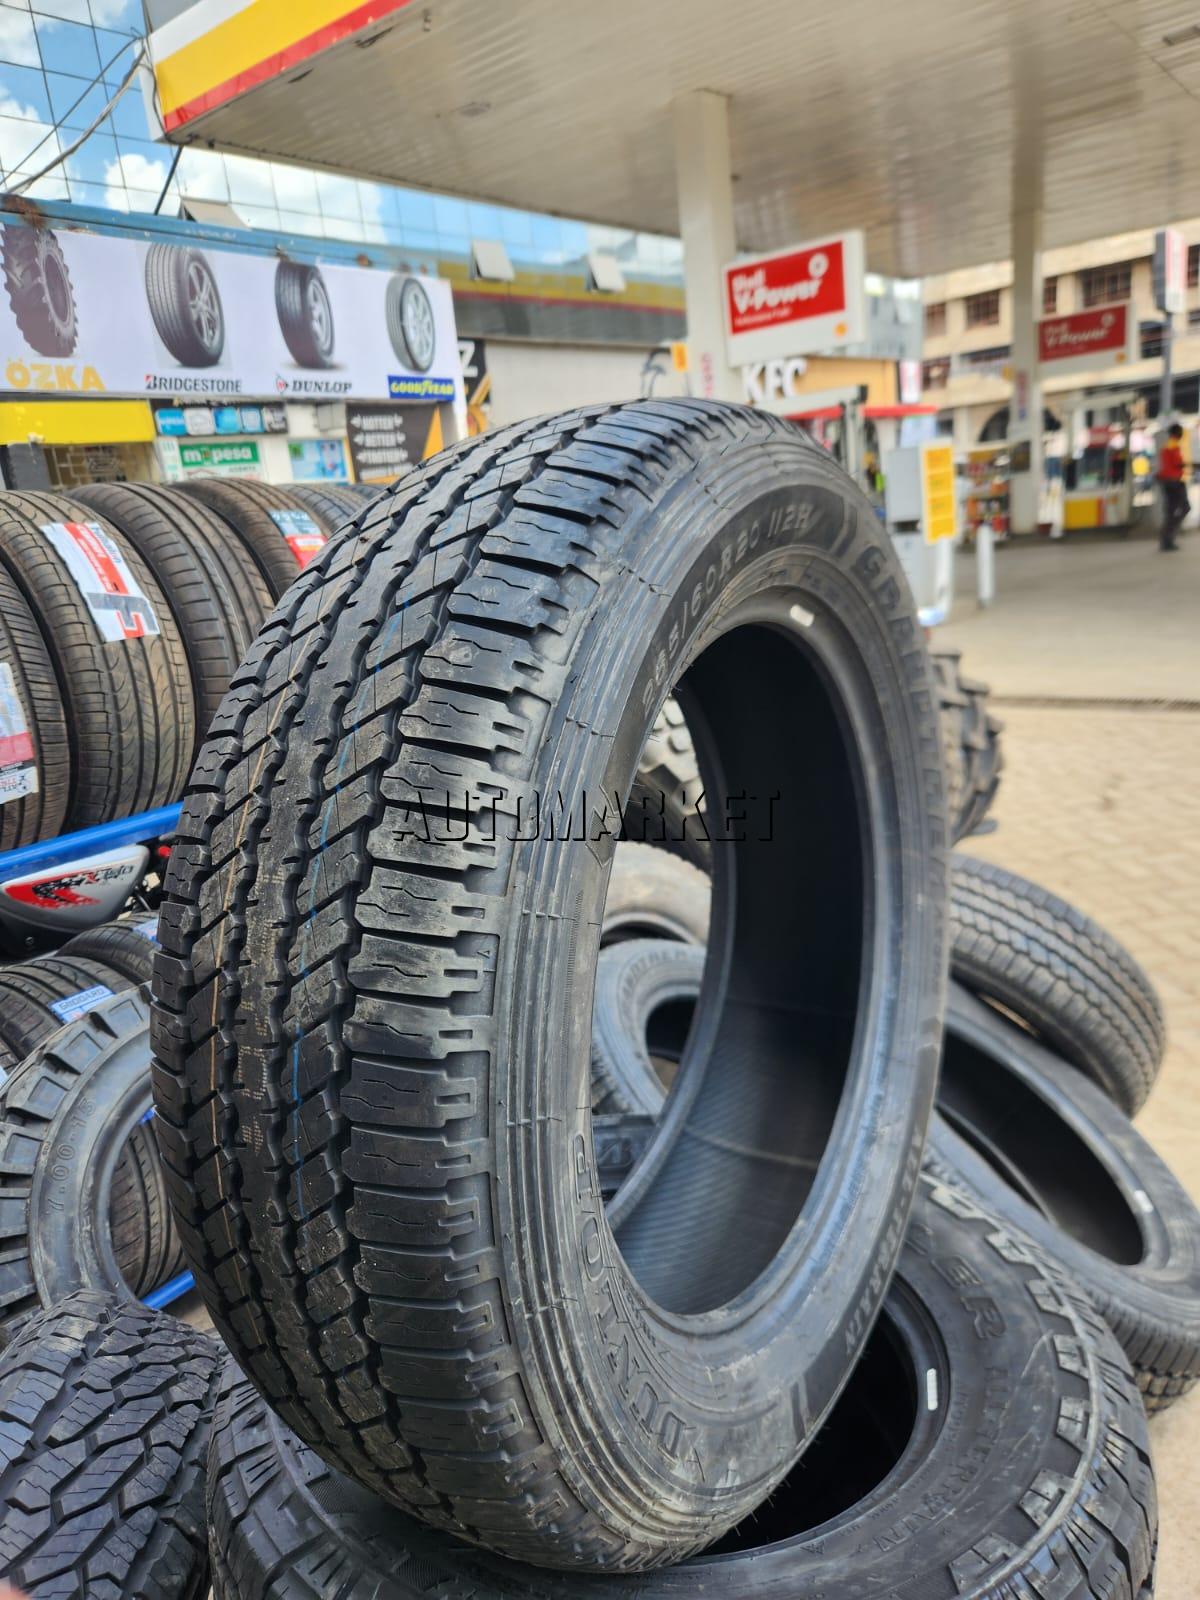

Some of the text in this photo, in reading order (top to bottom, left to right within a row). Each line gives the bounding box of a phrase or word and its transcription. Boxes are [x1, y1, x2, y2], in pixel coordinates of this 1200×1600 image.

[5, 356, 107, 392] ÖZKA
[144, 374, 242, 393] BRIDGESTONE
[291, 378, 353, 394] DUNLOP
[742, 357, 808, 399] KFC
[390, 380, 455, 397] GOODYEAR
[572, 1132, 688, 1463] DUNLOP
